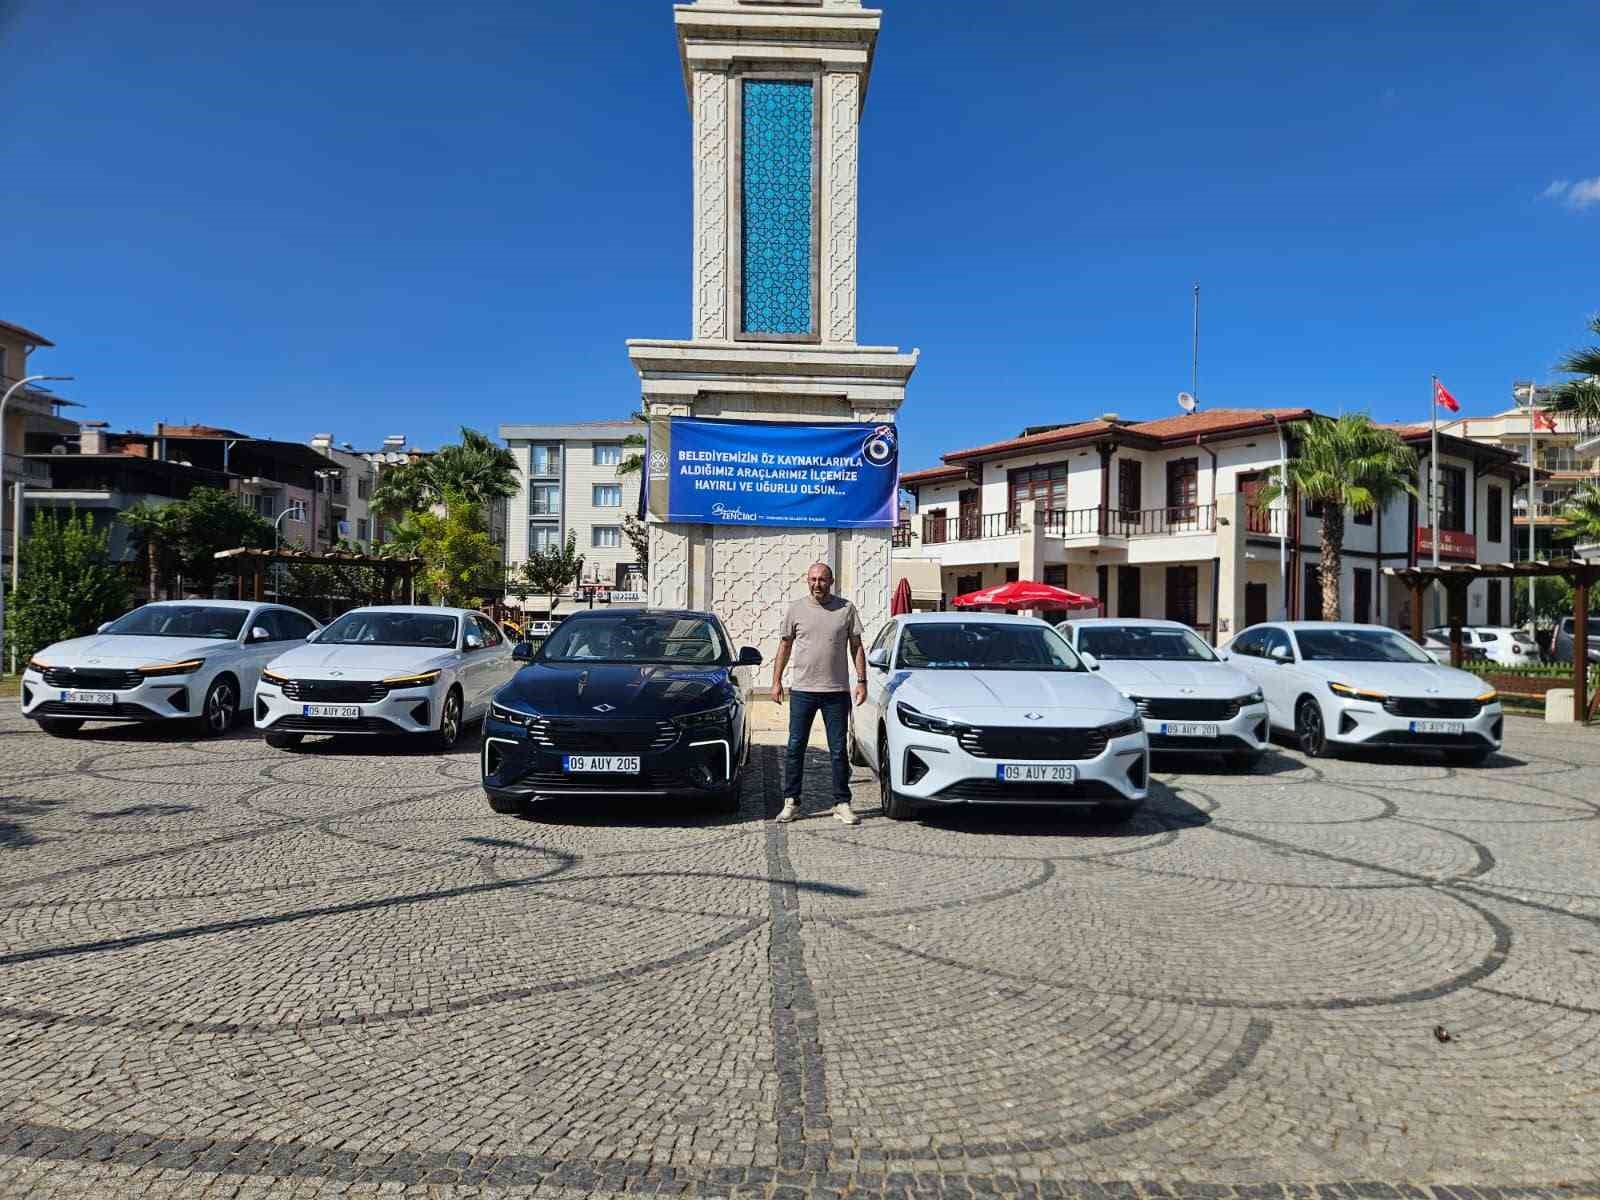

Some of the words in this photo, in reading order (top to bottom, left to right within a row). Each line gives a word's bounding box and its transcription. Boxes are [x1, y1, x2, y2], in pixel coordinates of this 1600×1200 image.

[678, 450, 758, 464] BELEDİYEMİZİN
[762, 452, 775, 464] ÖZ
[777, 455, 863, 467] KAYNAKLARIYLA
[680, 464, 734, 477] ALDIĞIMIZ
[736, 467, 808, 481] ARAÇLARIMIZ
[810, 469, 858, 482] İLÇEMİZE
[695, 479, 737, 491] HAYIRLI
[739, 481, 753, 492] VE
[756, 481, 798, 494] UĞURLU
[800, 484, 846, 495] OLSUN...
[309, 706, 320, 715] 09
[323, 706, 338, 716] AUY
[341, 707, 357, 717] 204
[1182, 725, 1198, 734] AUY
[570, 756, 584, 770] 09
[590, 757, 612, 770] AUY
[616, 757, 638, 770] 205
[1005, 766, 1019, 779] 09
[1025, 767, 1047, 779] AUY
[1051, 767, 1072, 779] 203
